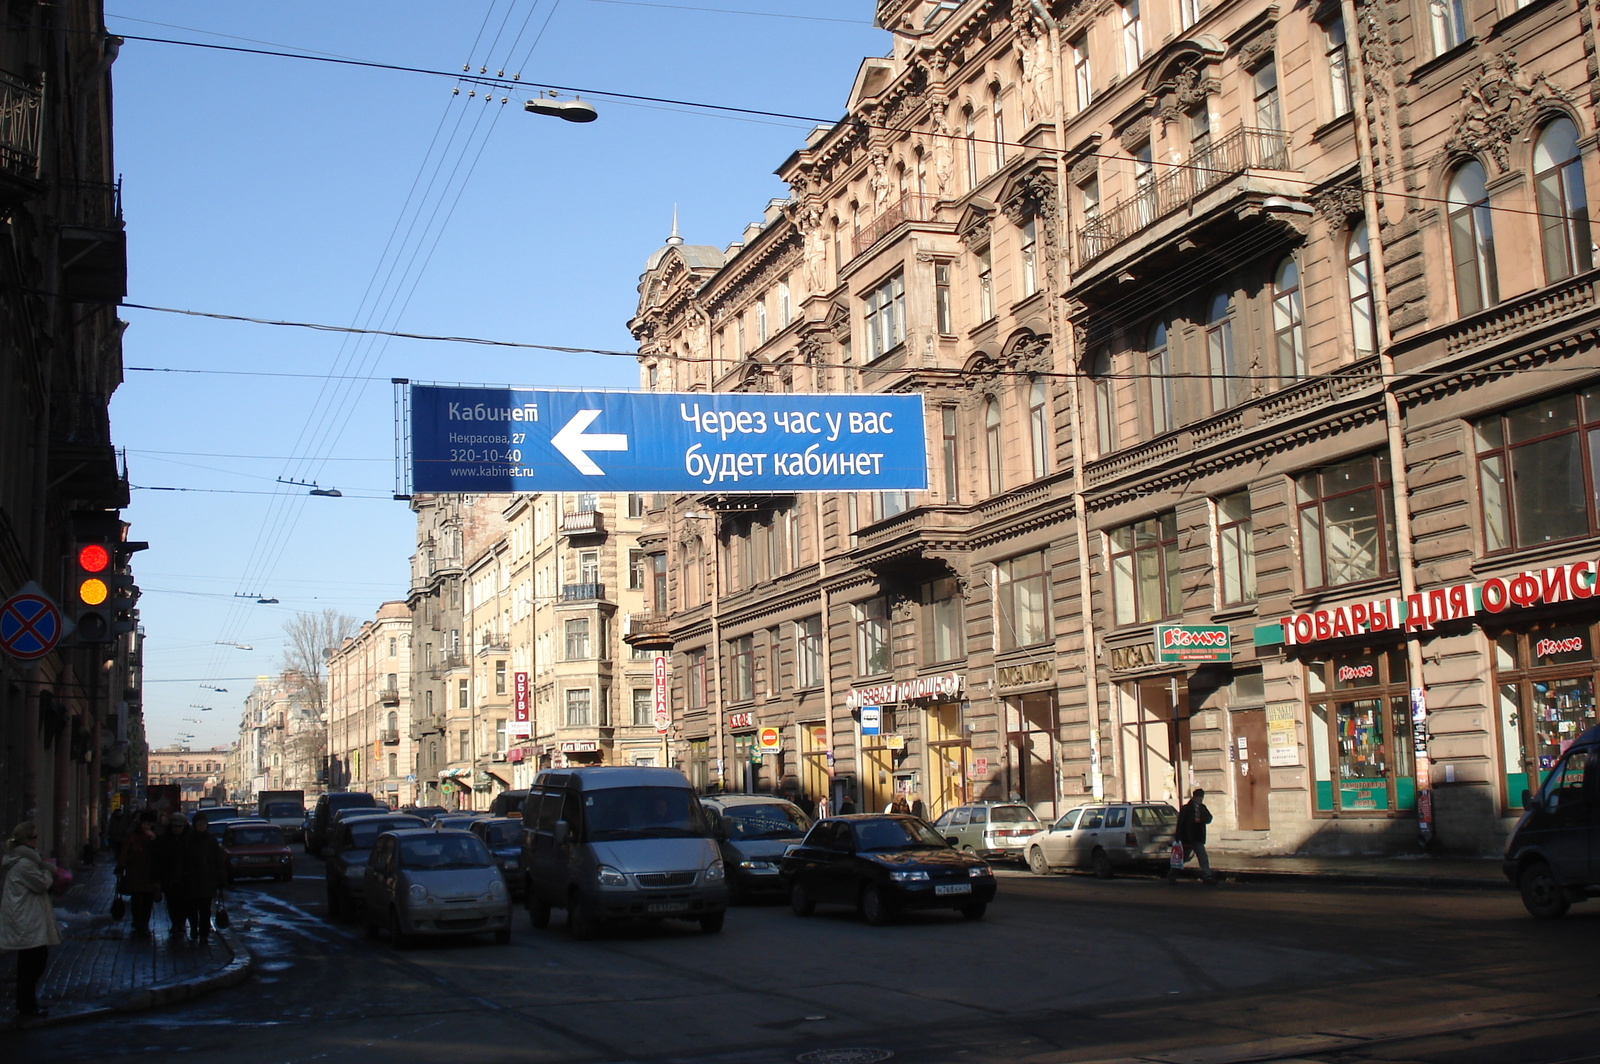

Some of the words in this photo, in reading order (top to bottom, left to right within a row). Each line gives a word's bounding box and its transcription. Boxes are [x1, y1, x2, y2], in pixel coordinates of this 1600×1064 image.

[448, 401, 539, 423] Кабинет
[680, 402, 767, 441] Через
[773, 411, 821, 434] час
[825, 409, 843, 441] у
[849, 411, 893, 434] вас
[448, 433, 511, 446] Некрасова,
[512, 433, 526, 444] 27
[449, 448, 522, 462] 320-10-40
[450, 464, 534, 479] www.kabinet.ru
[685, 443, 767, 483] будет
[775, 443, 884, 476] кабинет
[1280, 597, 1399, 646] ТОВАРЫ
[1405, 583, 1475, 633] ДЛЯ
[1481, 559, 1600, 613] ОФИС
[517, 674, 526, 720] ОБУВЬ
[656, 658, 666, 711] АПТЕКА
[856, 684, 897, 706] ПЕРВАЯ
[897, 677, 942, 701] ПОМОЩЬ
